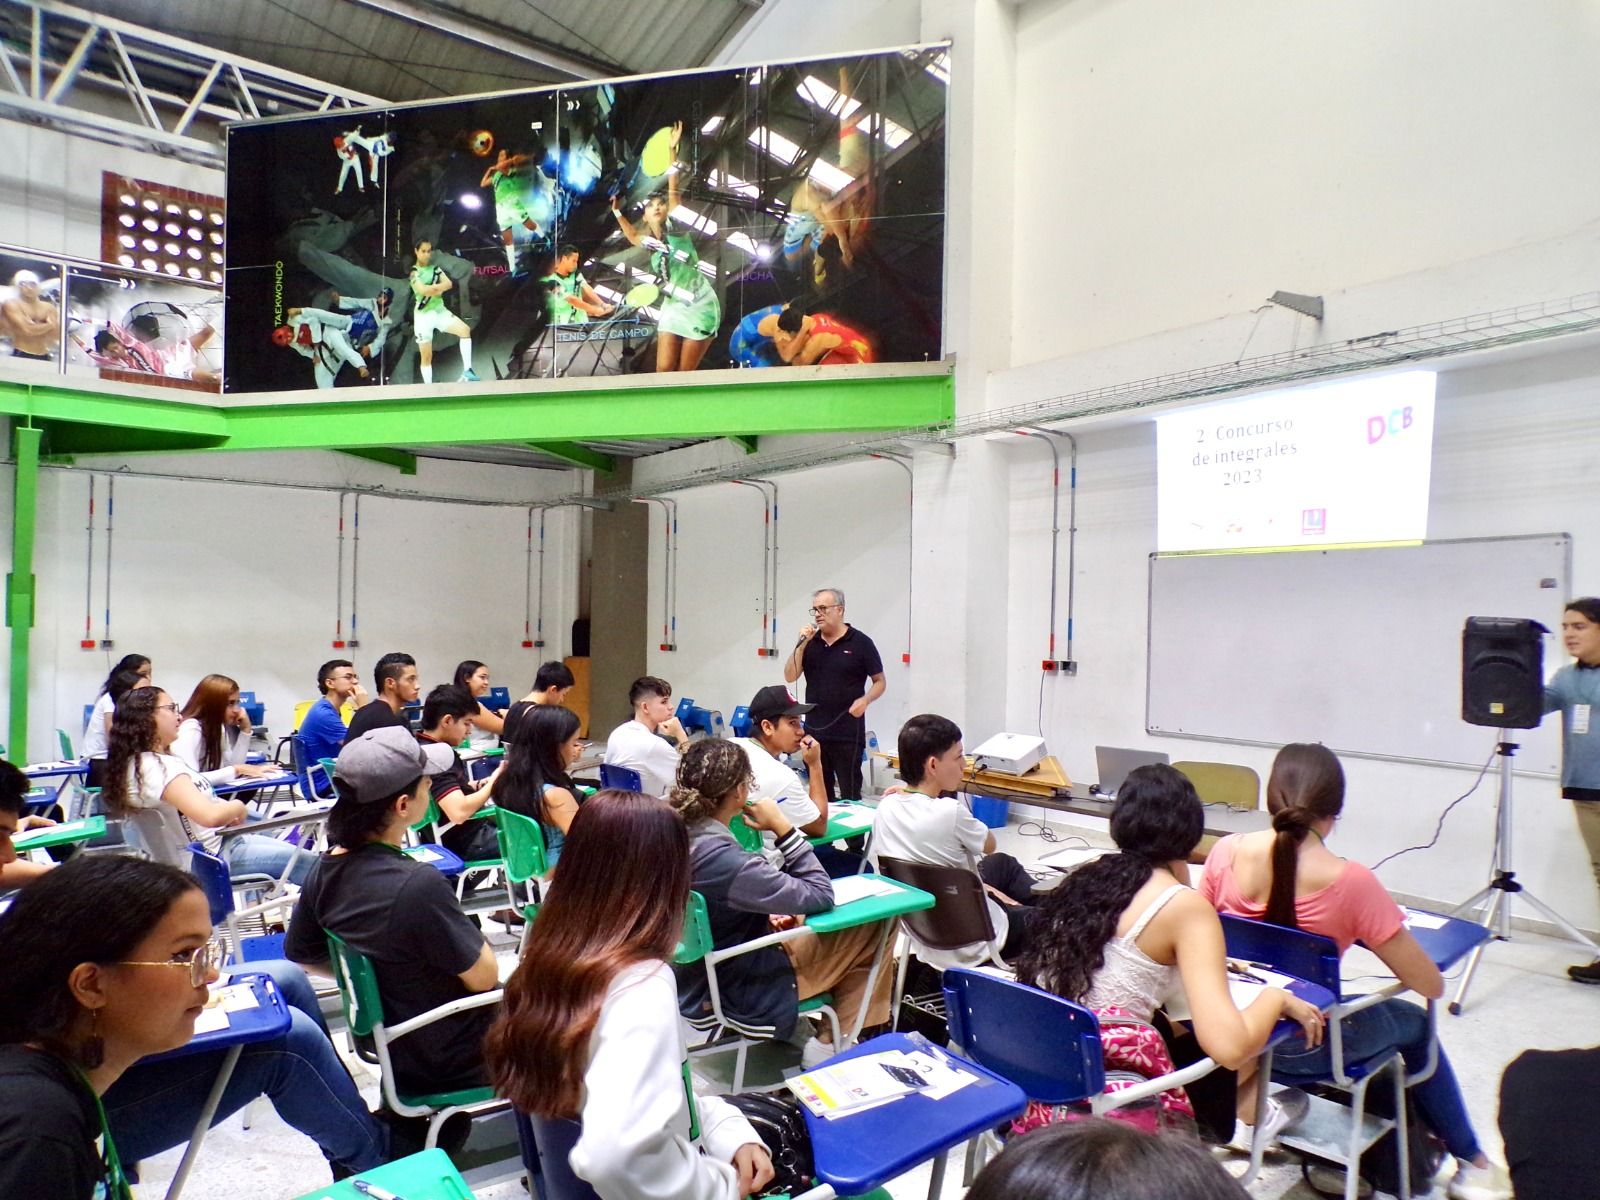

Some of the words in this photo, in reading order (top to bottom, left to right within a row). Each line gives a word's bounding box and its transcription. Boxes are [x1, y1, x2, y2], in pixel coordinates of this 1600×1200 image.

[473, 265, 511, 274] FUTSAL
[736, 271, 774, 281] LUCHA
[275, 261, 283, 327] TAEKWONDO
[557, 332, 587, 341] TENIS
[591, 330, 605, 340] DE
[609, 327, 649, 339] CAMPO
[1196, 429, 1205, 443] 2
[1216, 418, 1293, 441] Concurso
[1367, 405, 1413, 445] DCB
[1192, 450, 1210, 467] de
[1215, 441, 1298, 464] integrales
[1222, 468, 1262, 486] 2023
